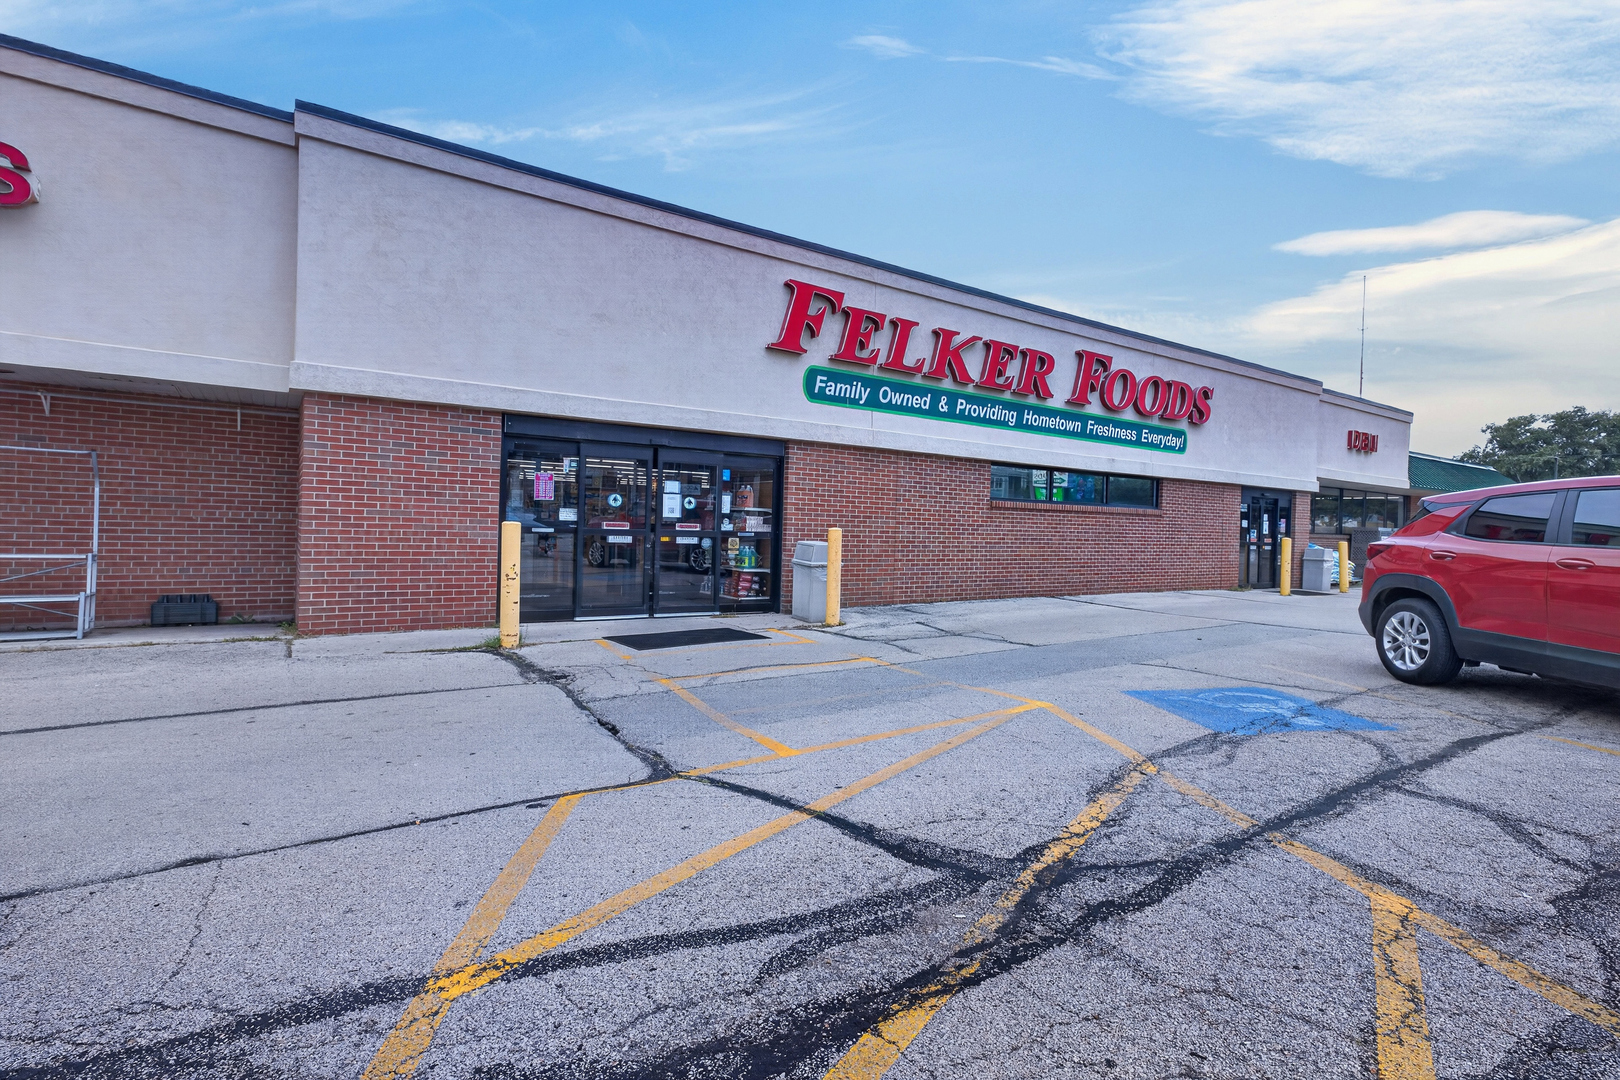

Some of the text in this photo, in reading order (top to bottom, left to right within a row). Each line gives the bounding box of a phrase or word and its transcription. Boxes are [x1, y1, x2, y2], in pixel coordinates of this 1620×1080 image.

[766, 279, 1214, 425] FELKER FOODS
[814, 375, 1185, 450] Family Owned & Providing Hometown Freshness Everyday!
[1347, 430, 1378, 452] DELI
